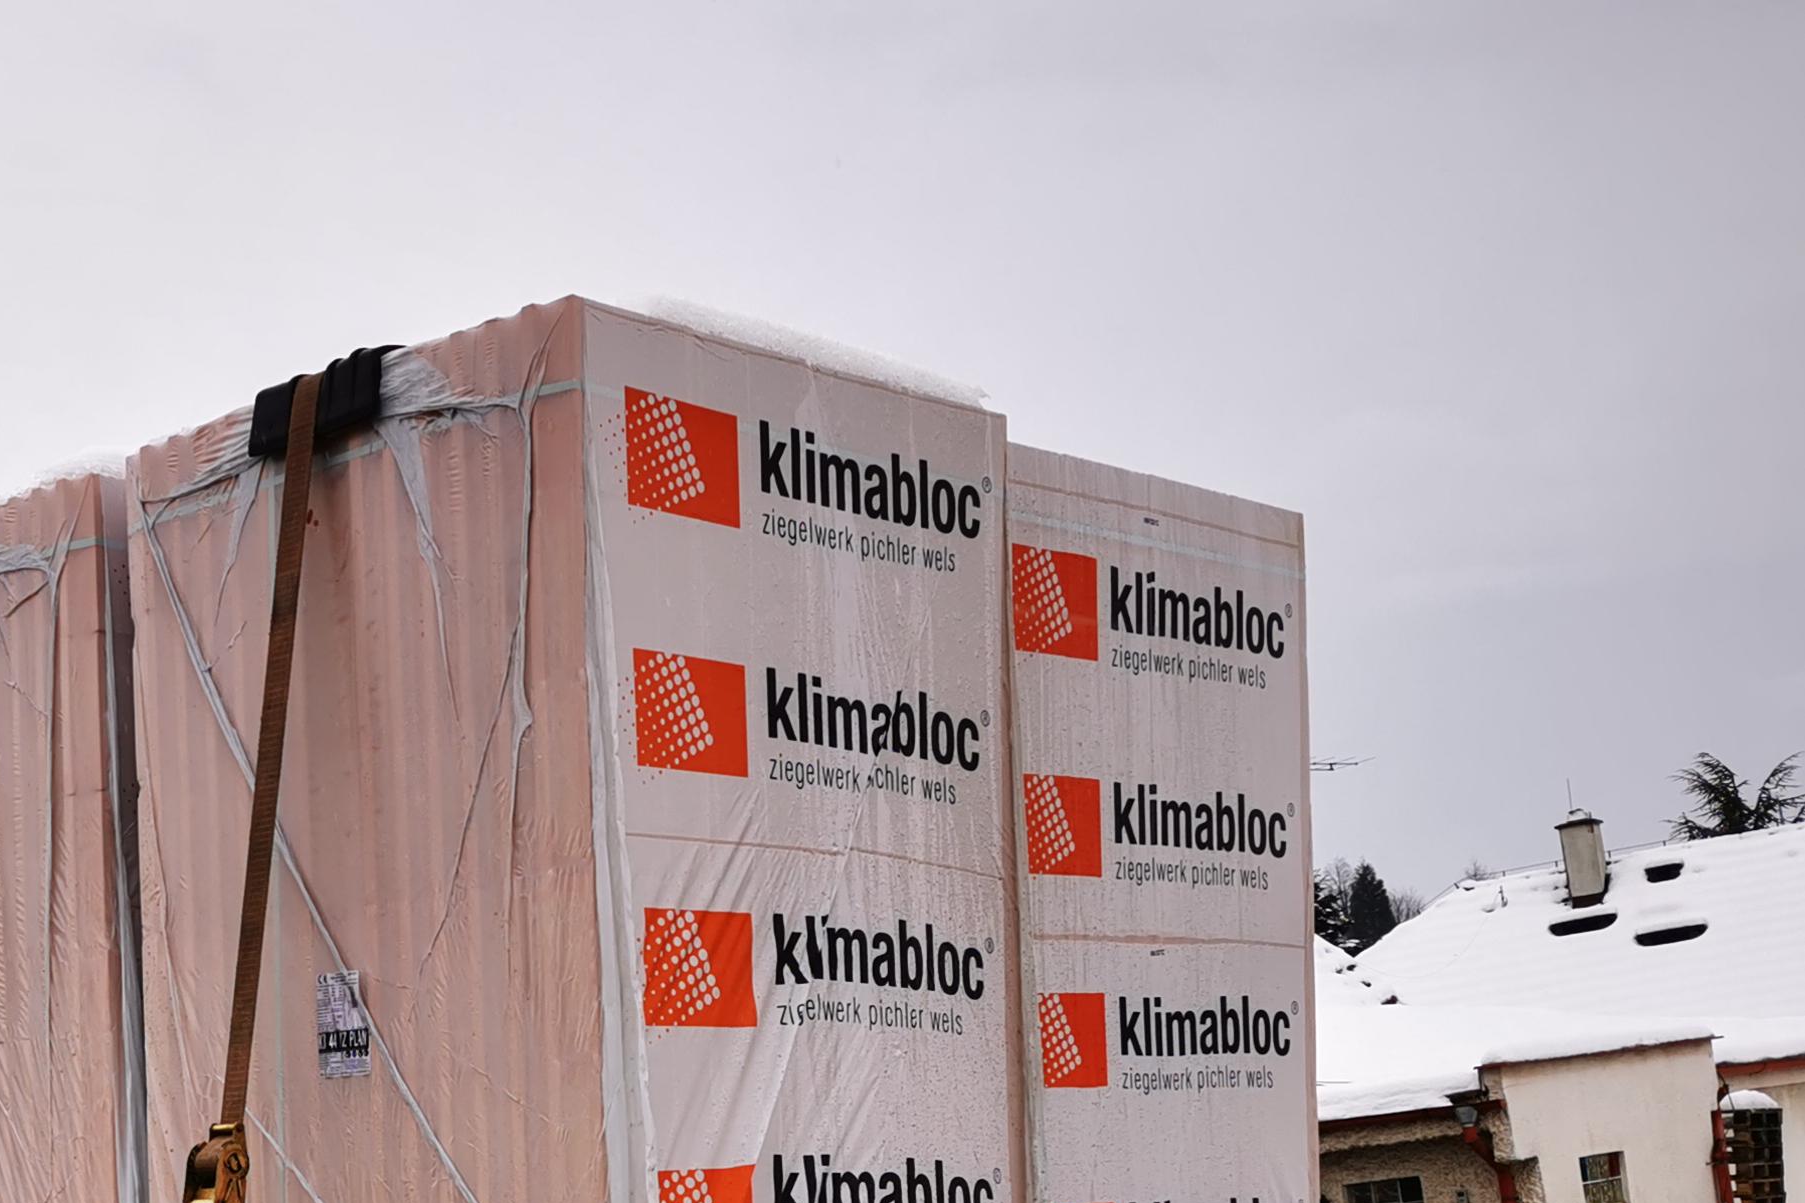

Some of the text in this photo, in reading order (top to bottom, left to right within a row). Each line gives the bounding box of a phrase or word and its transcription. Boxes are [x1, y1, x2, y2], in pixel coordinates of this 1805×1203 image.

[761, 508, 956, 572] ziegelwerk pichler wels
[1111, 644, 1266, 689] ziegelwerk pichler wels
[769, 753, 957, 805] ziegelwerk chler wels
[1115, 856, 1269, 891] ziegelwerk pichler wels
[868, 999, 924, 1031] pichler
[930, 1007, 964, 1036] wels
[1121, 1065, 1274, 1095] ziegelwerk pichler wels
